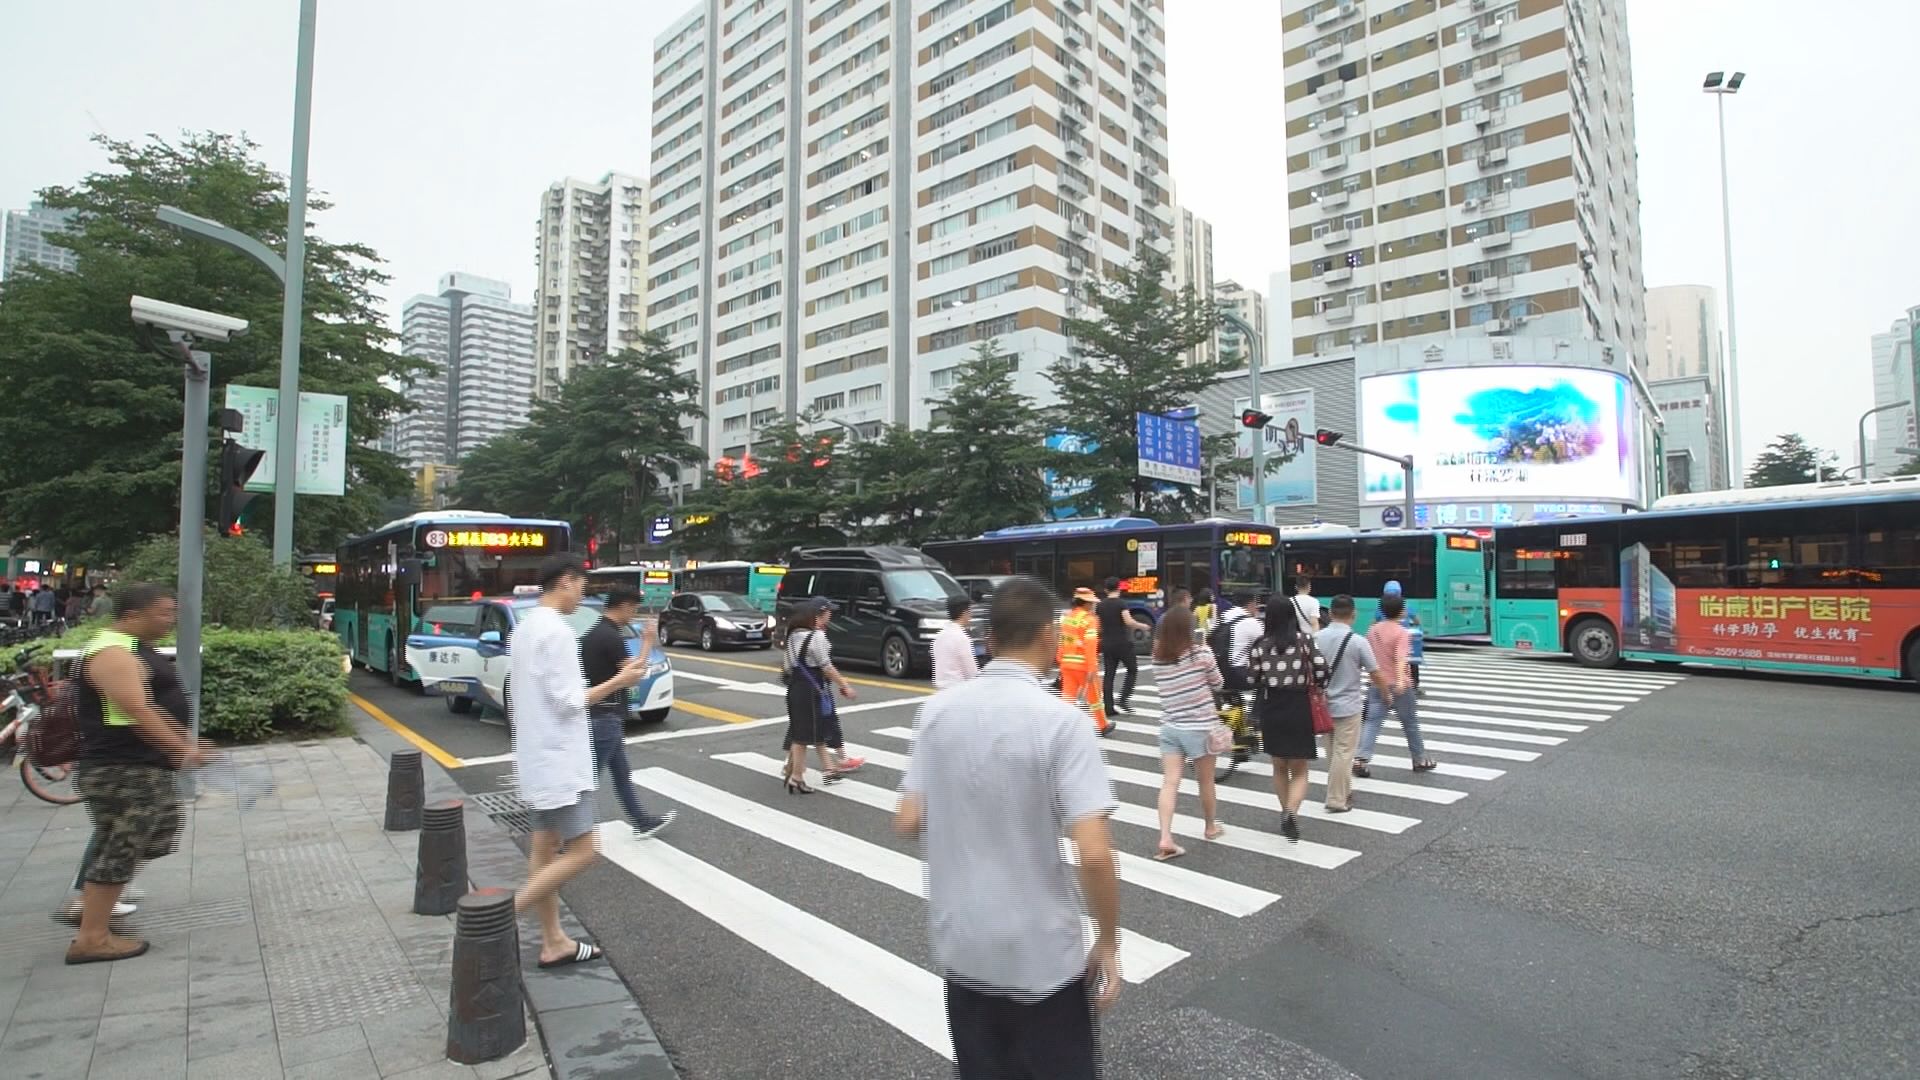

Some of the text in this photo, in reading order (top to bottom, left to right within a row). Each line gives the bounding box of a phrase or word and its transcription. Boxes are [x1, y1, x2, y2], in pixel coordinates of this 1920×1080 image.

[429, 532, 446, 545] 83
[1700, 596, 1872, 622] 怡康妇产医院
[1713, 623, 1860, 642] 科学助孕 优生优育
[429, 651, 460, 664] 康达尔
